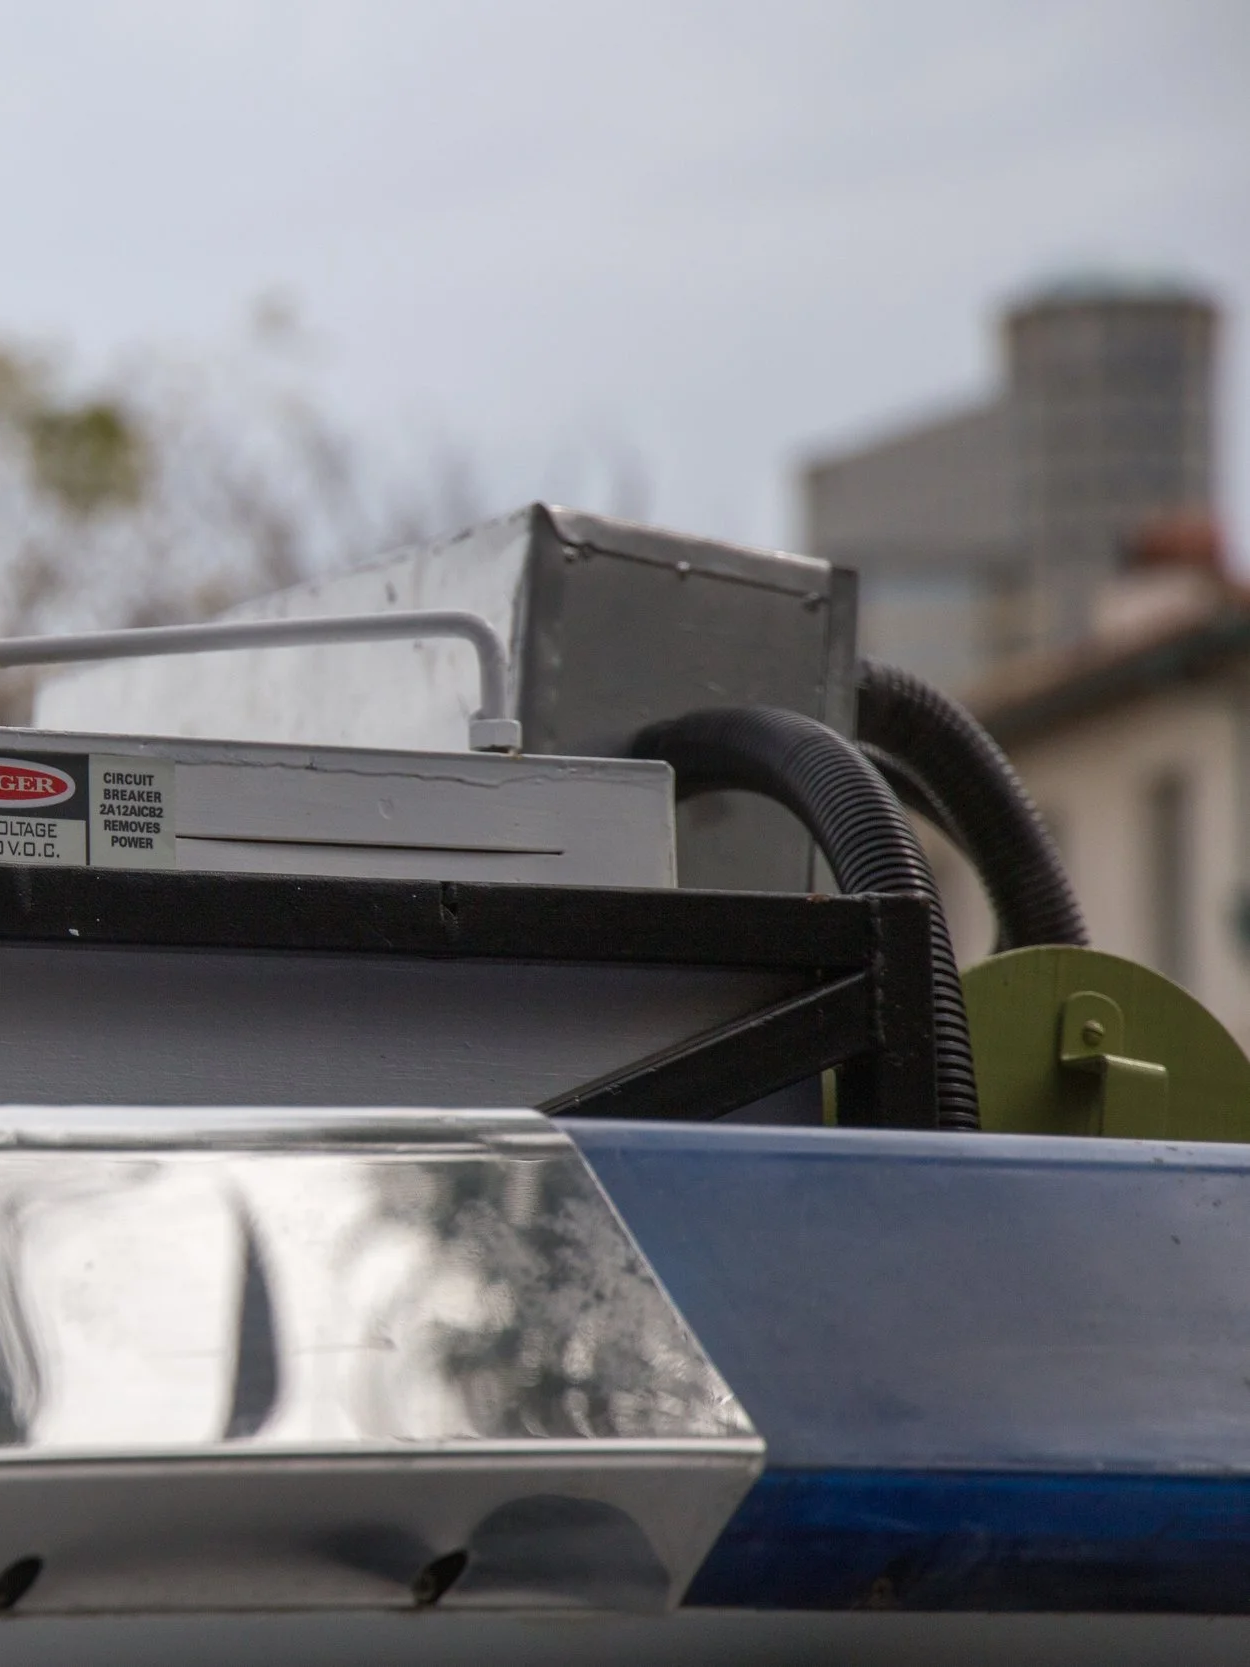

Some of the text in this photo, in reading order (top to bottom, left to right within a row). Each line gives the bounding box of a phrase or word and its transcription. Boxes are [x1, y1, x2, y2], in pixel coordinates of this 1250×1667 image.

[103, 772, 154, 786] CIRCUIT
[104, 789, 161, 802] BREAKER
[104, 820, 160, 833] REMOVES
[111, 836, 153, 849] POWER
